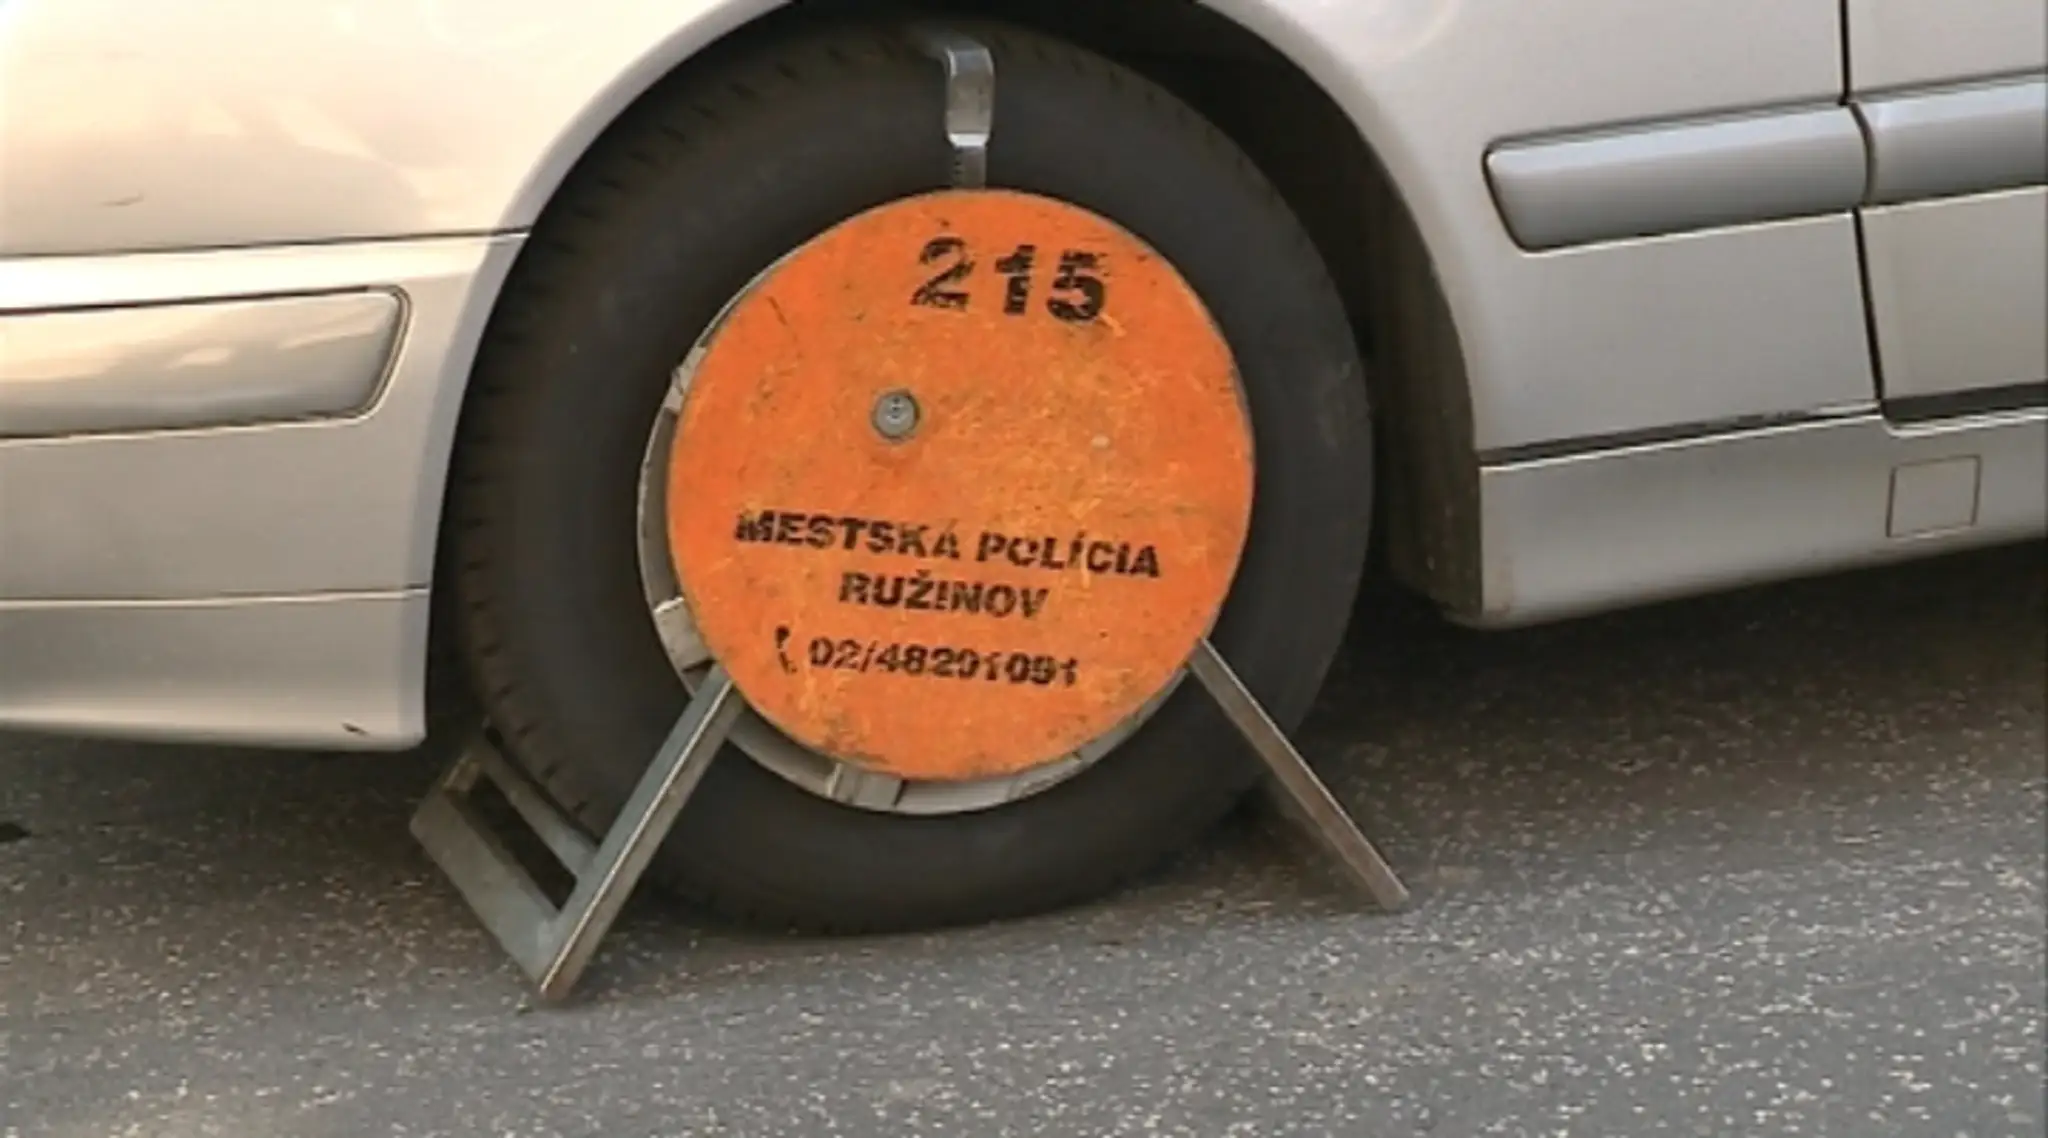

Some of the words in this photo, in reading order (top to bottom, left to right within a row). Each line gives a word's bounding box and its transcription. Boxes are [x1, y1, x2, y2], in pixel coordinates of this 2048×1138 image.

[909, 236, 1106, 322] 215
[734, 510, 960, 560] MESTSKÁ
[976, 531, 1161, 578] POLÍCIA
[838, 569, 1049, 618] RUŽINOV
